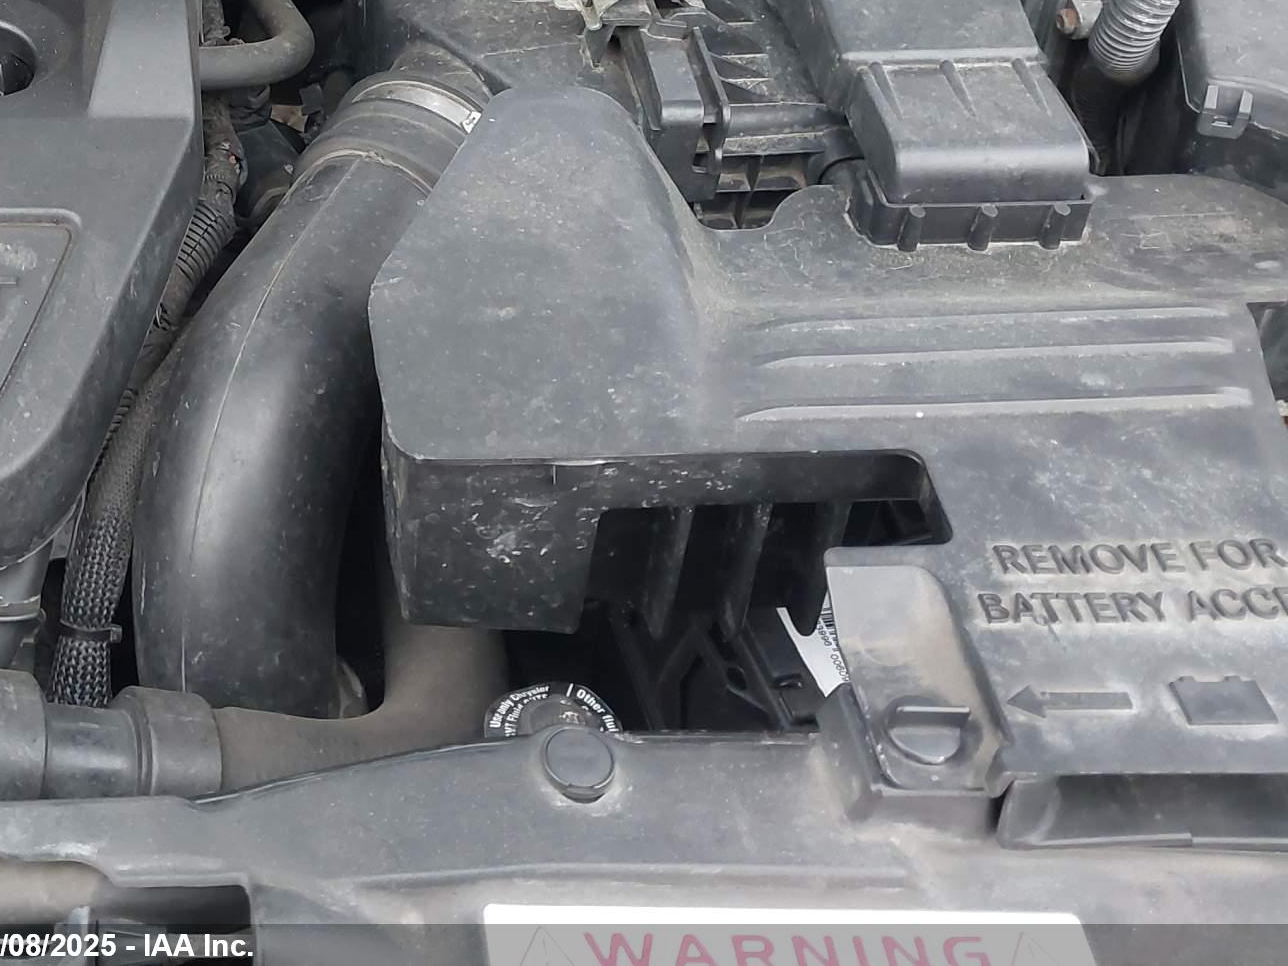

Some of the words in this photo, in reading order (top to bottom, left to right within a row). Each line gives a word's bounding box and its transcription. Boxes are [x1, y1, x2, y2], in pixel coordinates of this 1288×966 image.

[992, 543, 1186, 575] REMOVE
[1189, 538, 1288, 571] FOR
[977, 590, 1165, 625] BATTERY
[576, 688, 606, 714] Other
[489, 713, 503, 728] Use
[583, 932, 990, 966] WARNING
